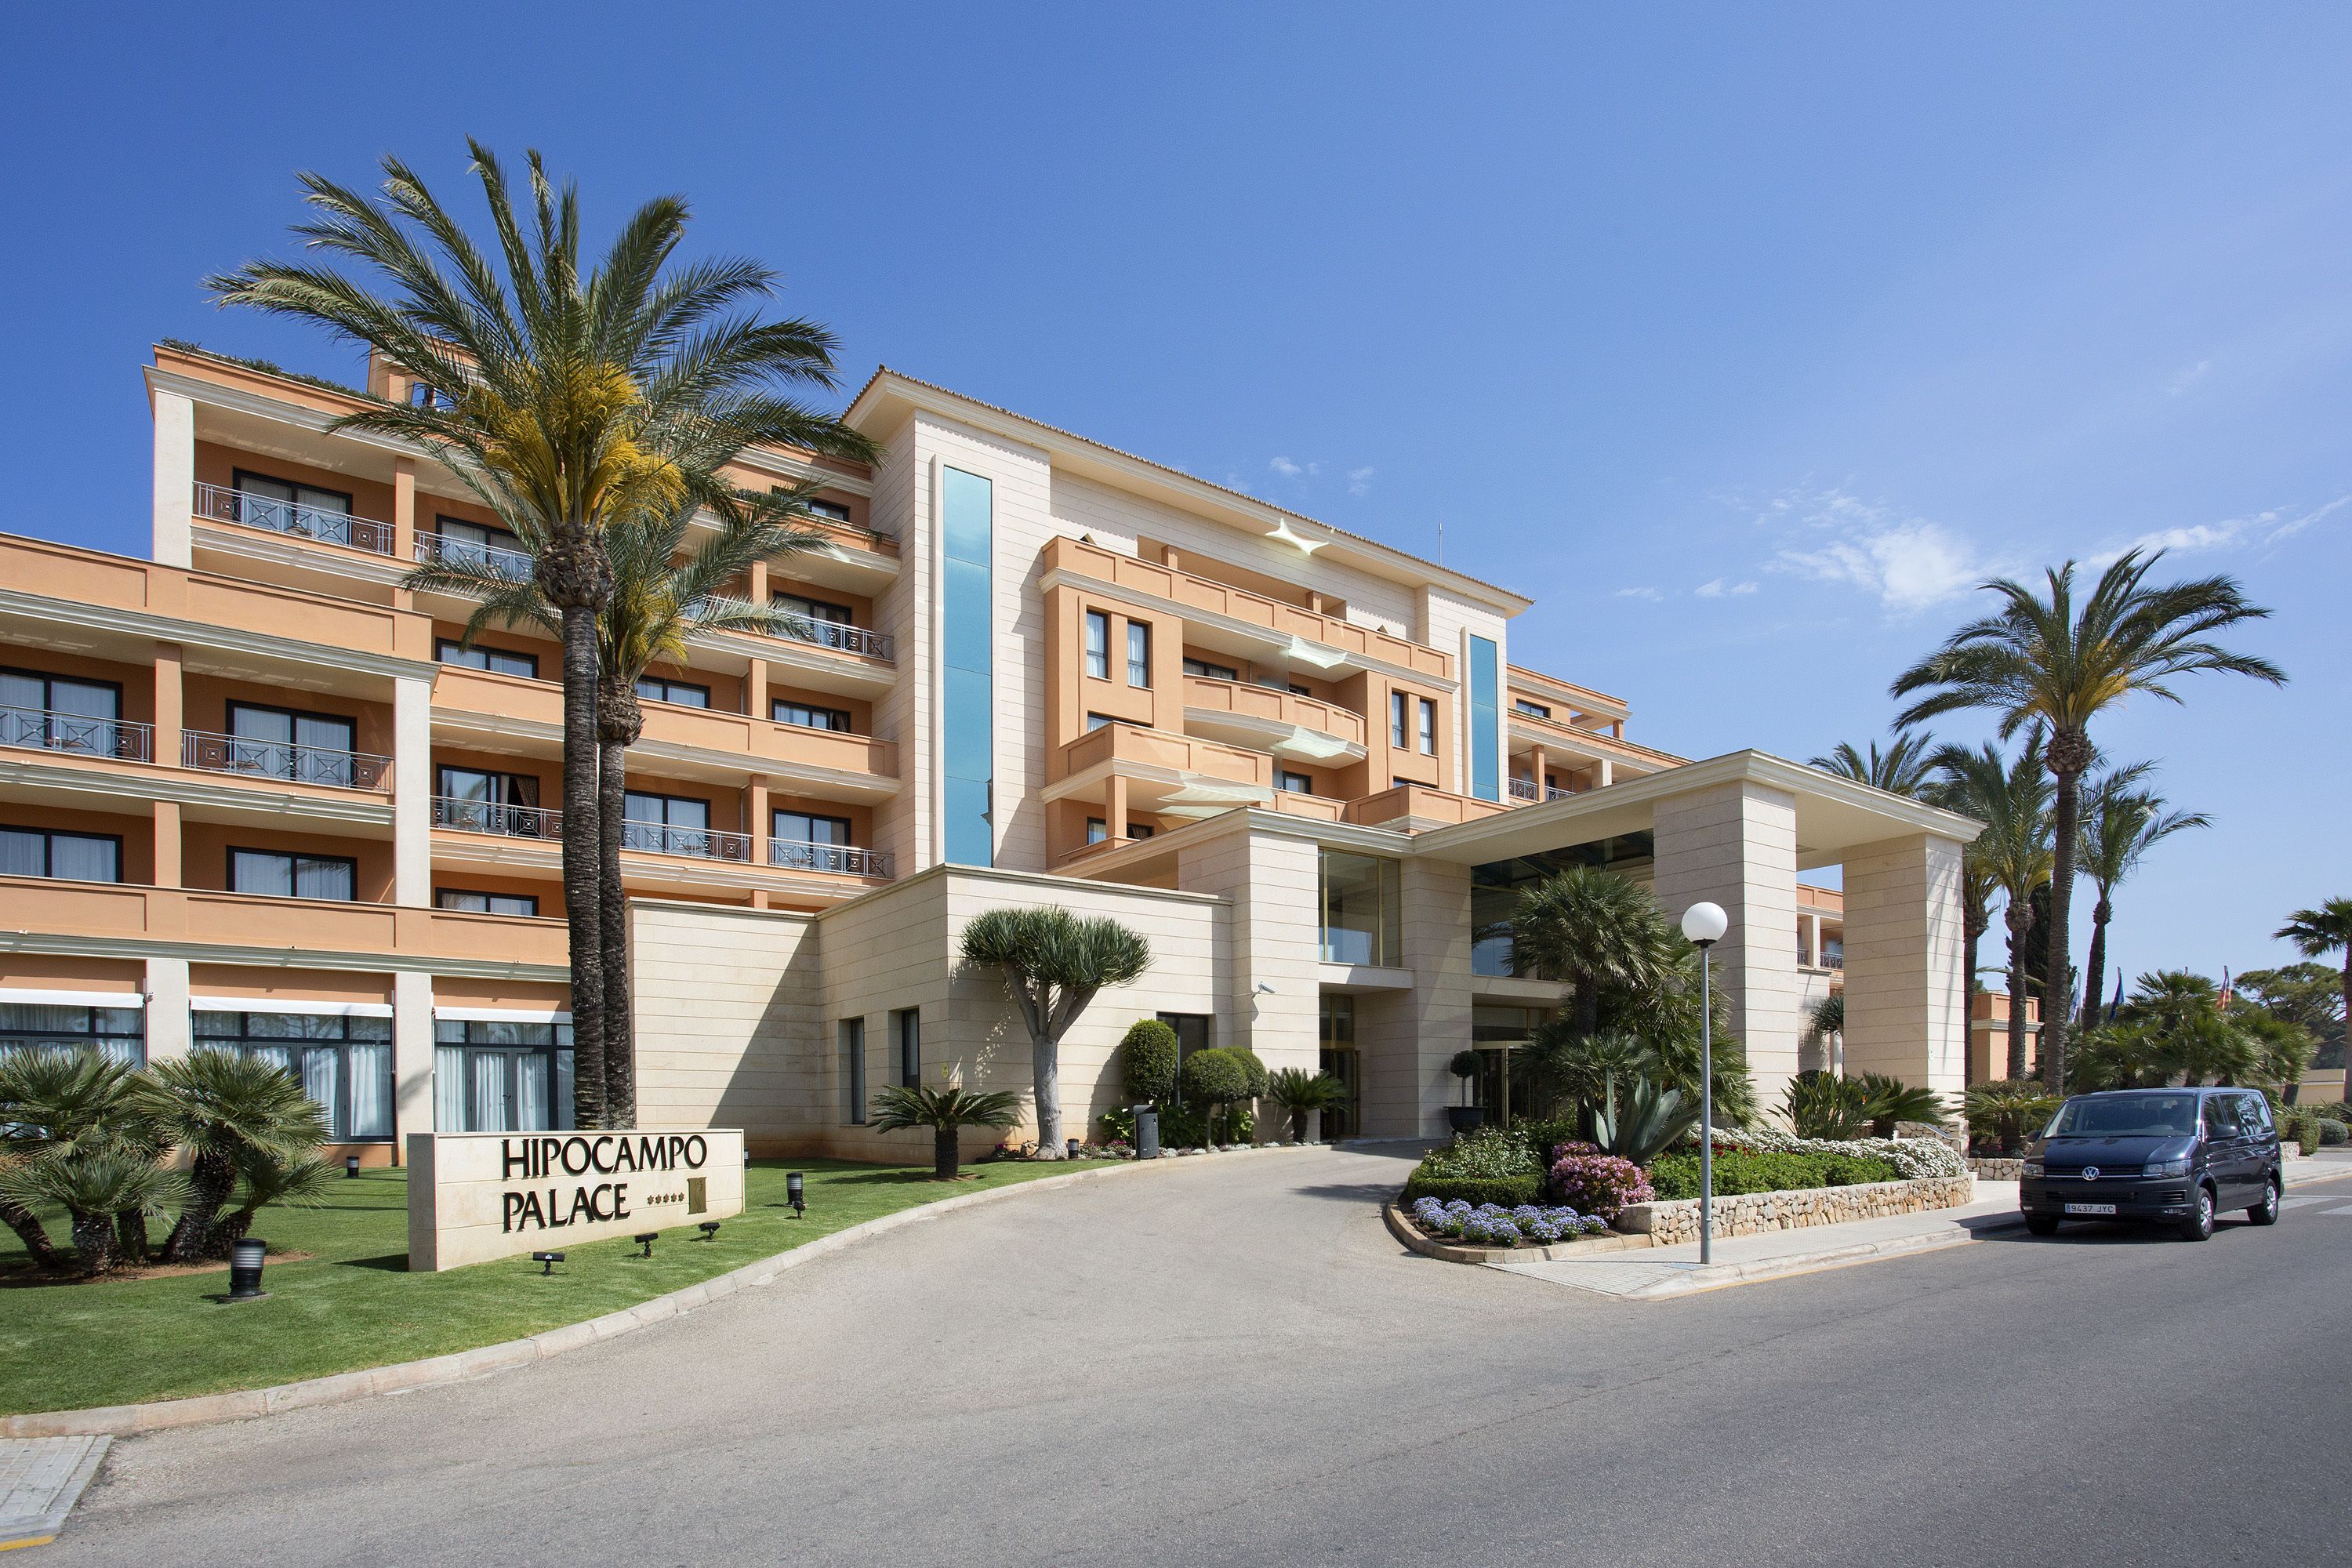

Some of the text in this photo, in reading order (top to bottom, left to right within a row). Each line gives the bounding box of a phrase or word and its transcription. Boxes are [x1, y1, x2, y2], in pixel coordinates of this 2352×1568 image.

[502, 1135, 707, 1181] HIPOCAMPO
[502, 1182, 631, 1233] PALACE
[2071, 1204, 2093, 1213] 9437
